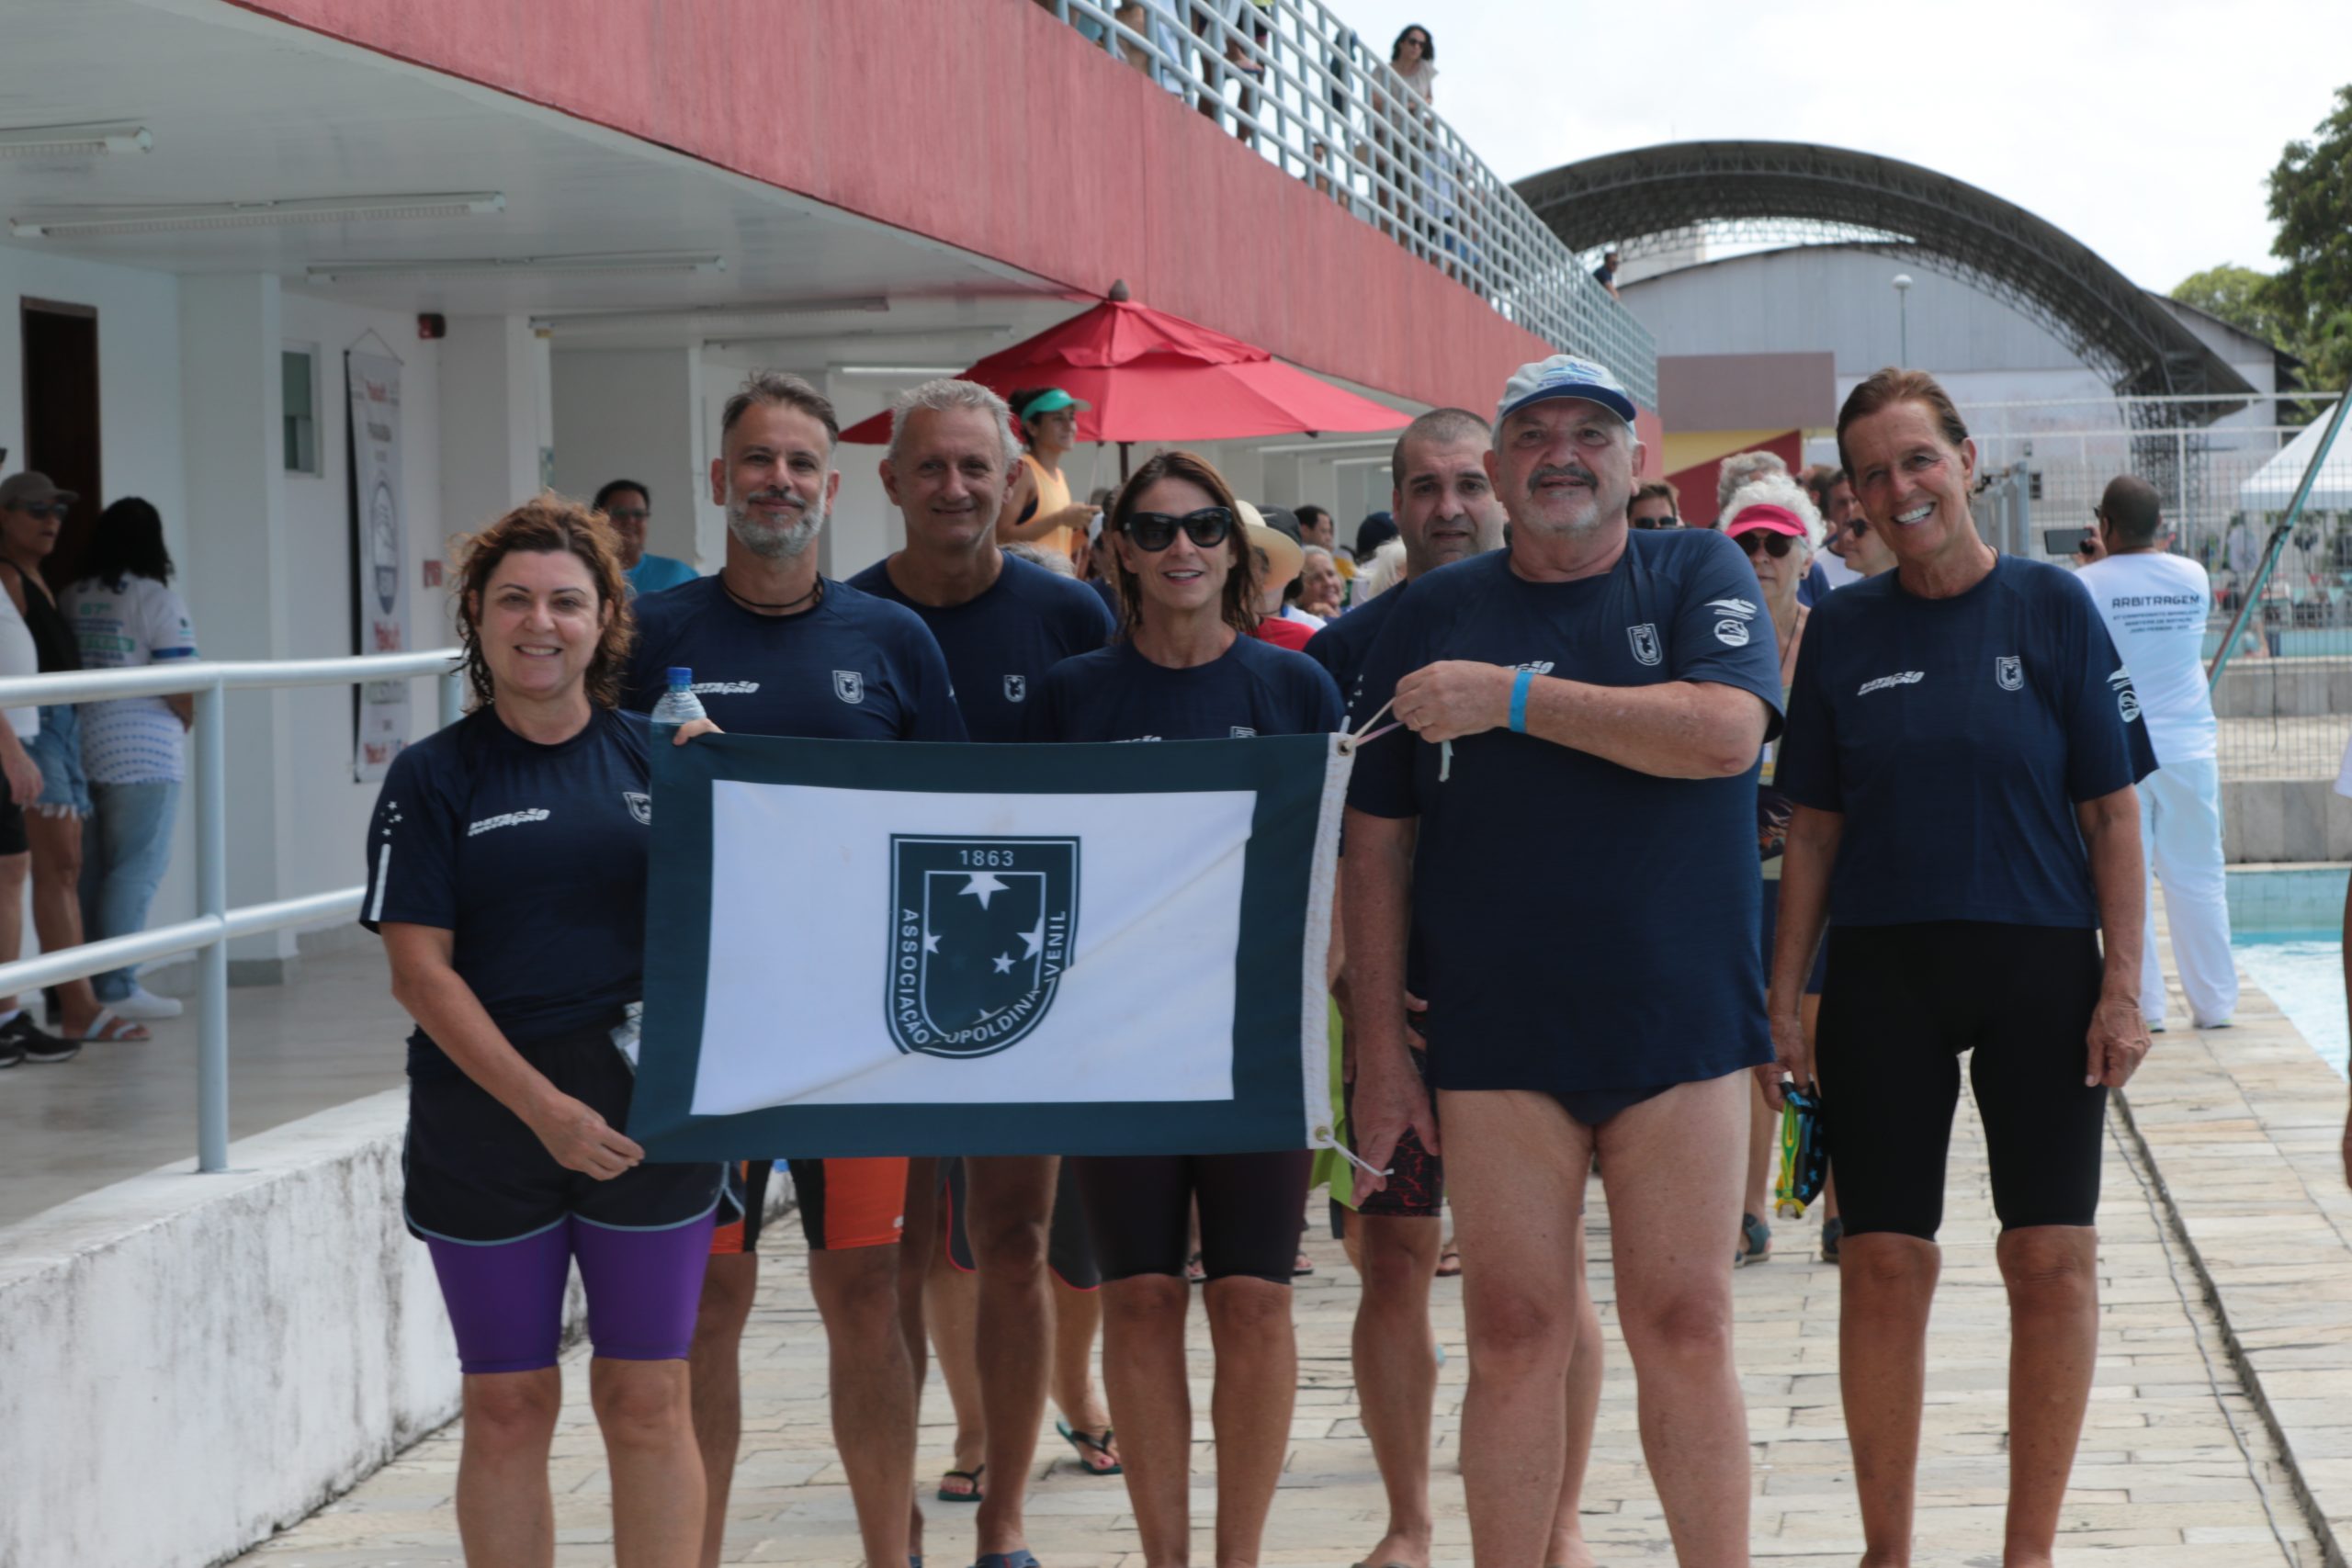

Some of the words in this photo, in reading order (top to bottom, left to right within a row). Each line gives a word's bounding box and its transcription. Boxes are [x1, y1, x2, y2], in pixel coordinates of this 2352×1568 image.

[2112, 595, 2199, 608] ARBITRAGEM
[959, 850, 1014, 866] 1863
[899, 908, 930, 1044] ASSOCIAÇÃO
